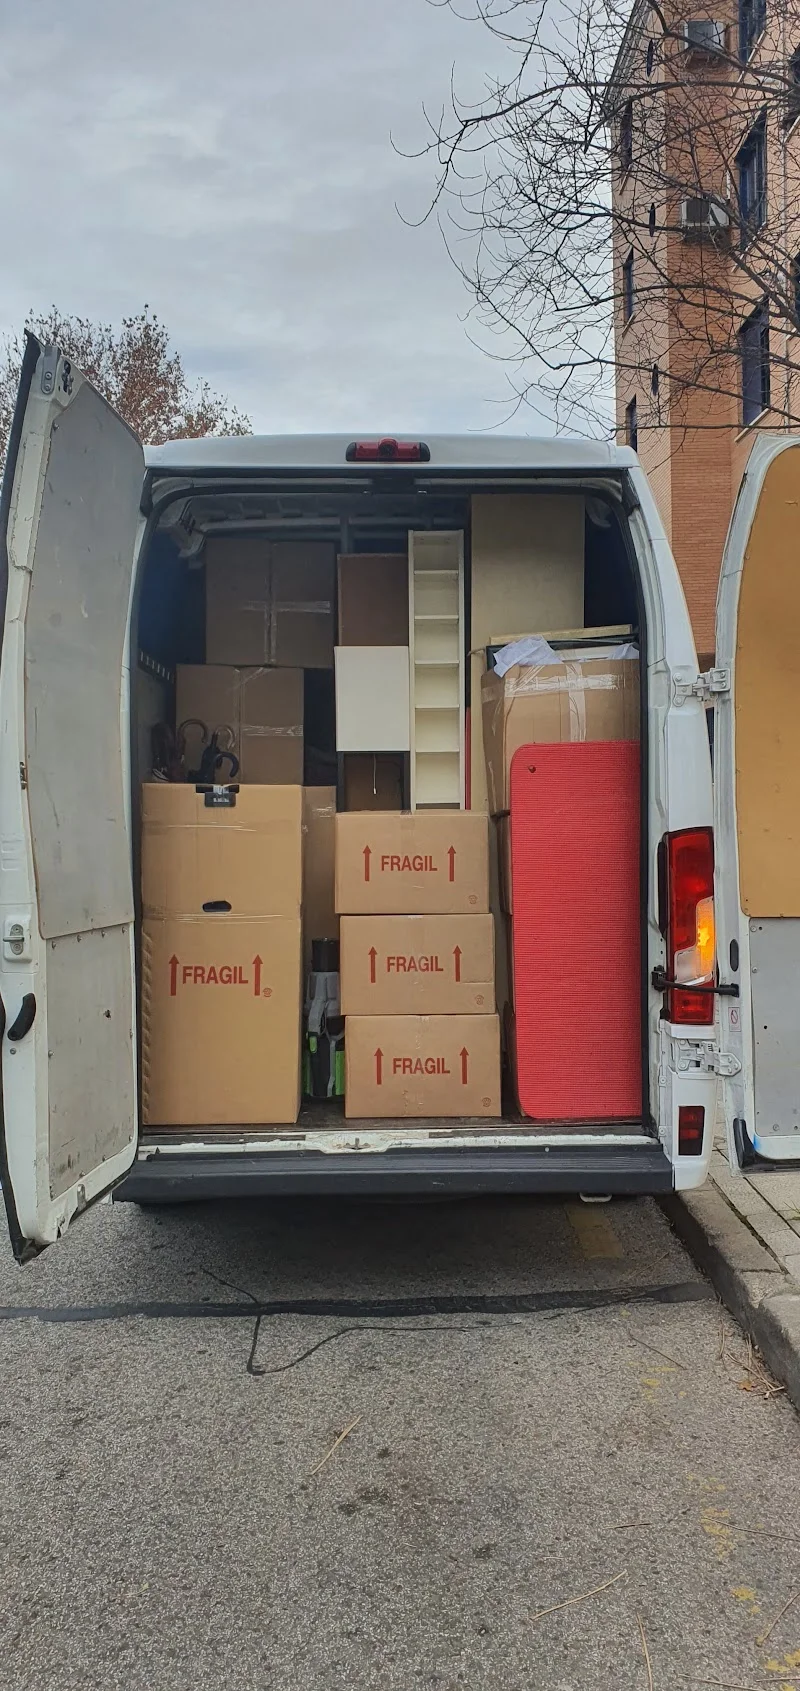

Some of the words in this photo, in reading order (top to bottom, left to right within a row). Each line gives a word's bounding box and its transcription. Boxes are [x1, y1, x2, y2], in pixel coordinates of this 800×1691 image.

[381, 855, 438, 873] FRAGIL
[386, 955, 444, 973] FRAGIL
[182, 965, 249, 985] FRAGIL
[393, 1057, 450, 1075] FRAGIL
